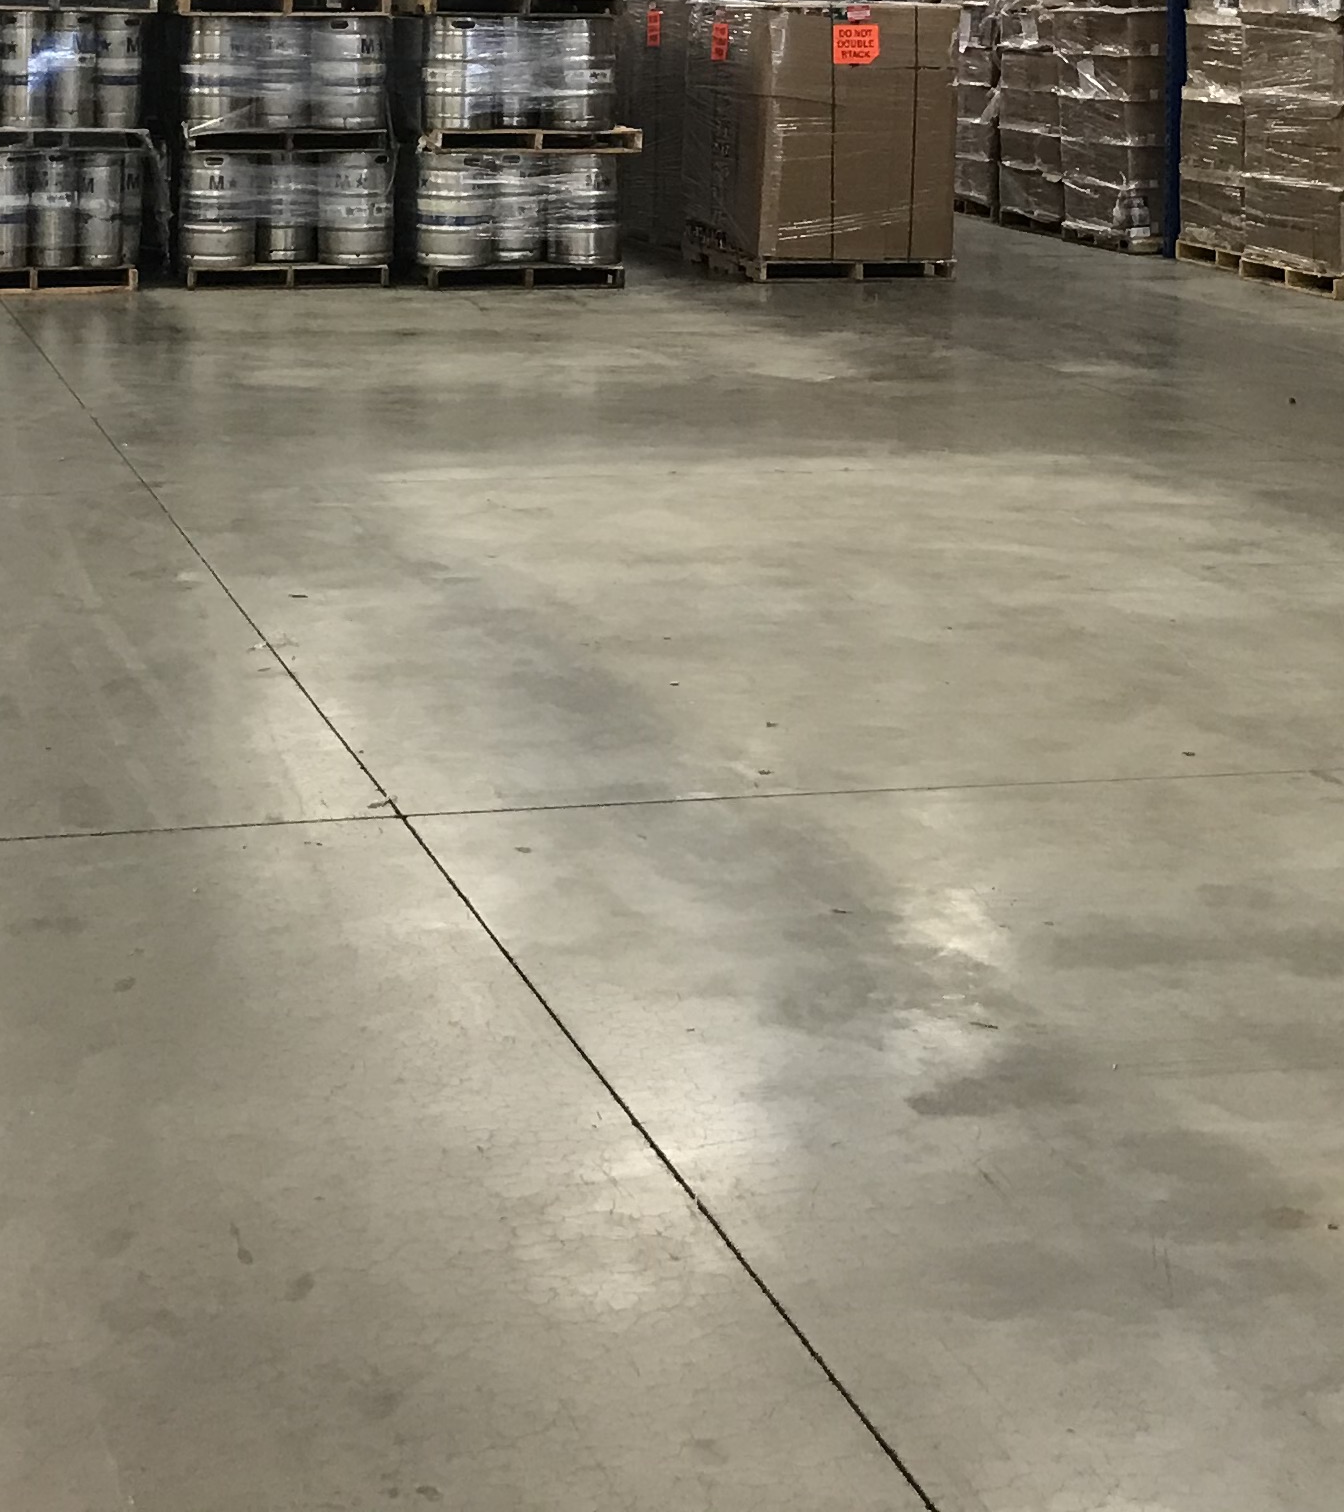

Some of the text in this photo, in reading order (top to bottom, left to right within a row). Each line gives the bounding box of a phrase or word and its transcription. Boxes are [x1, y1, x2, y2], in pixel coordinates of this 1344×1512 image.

[838, 29, 873, 38] DO NOT
[837, 40, 874, 48] DOUBLE
[209, 175, 224, 190] M
